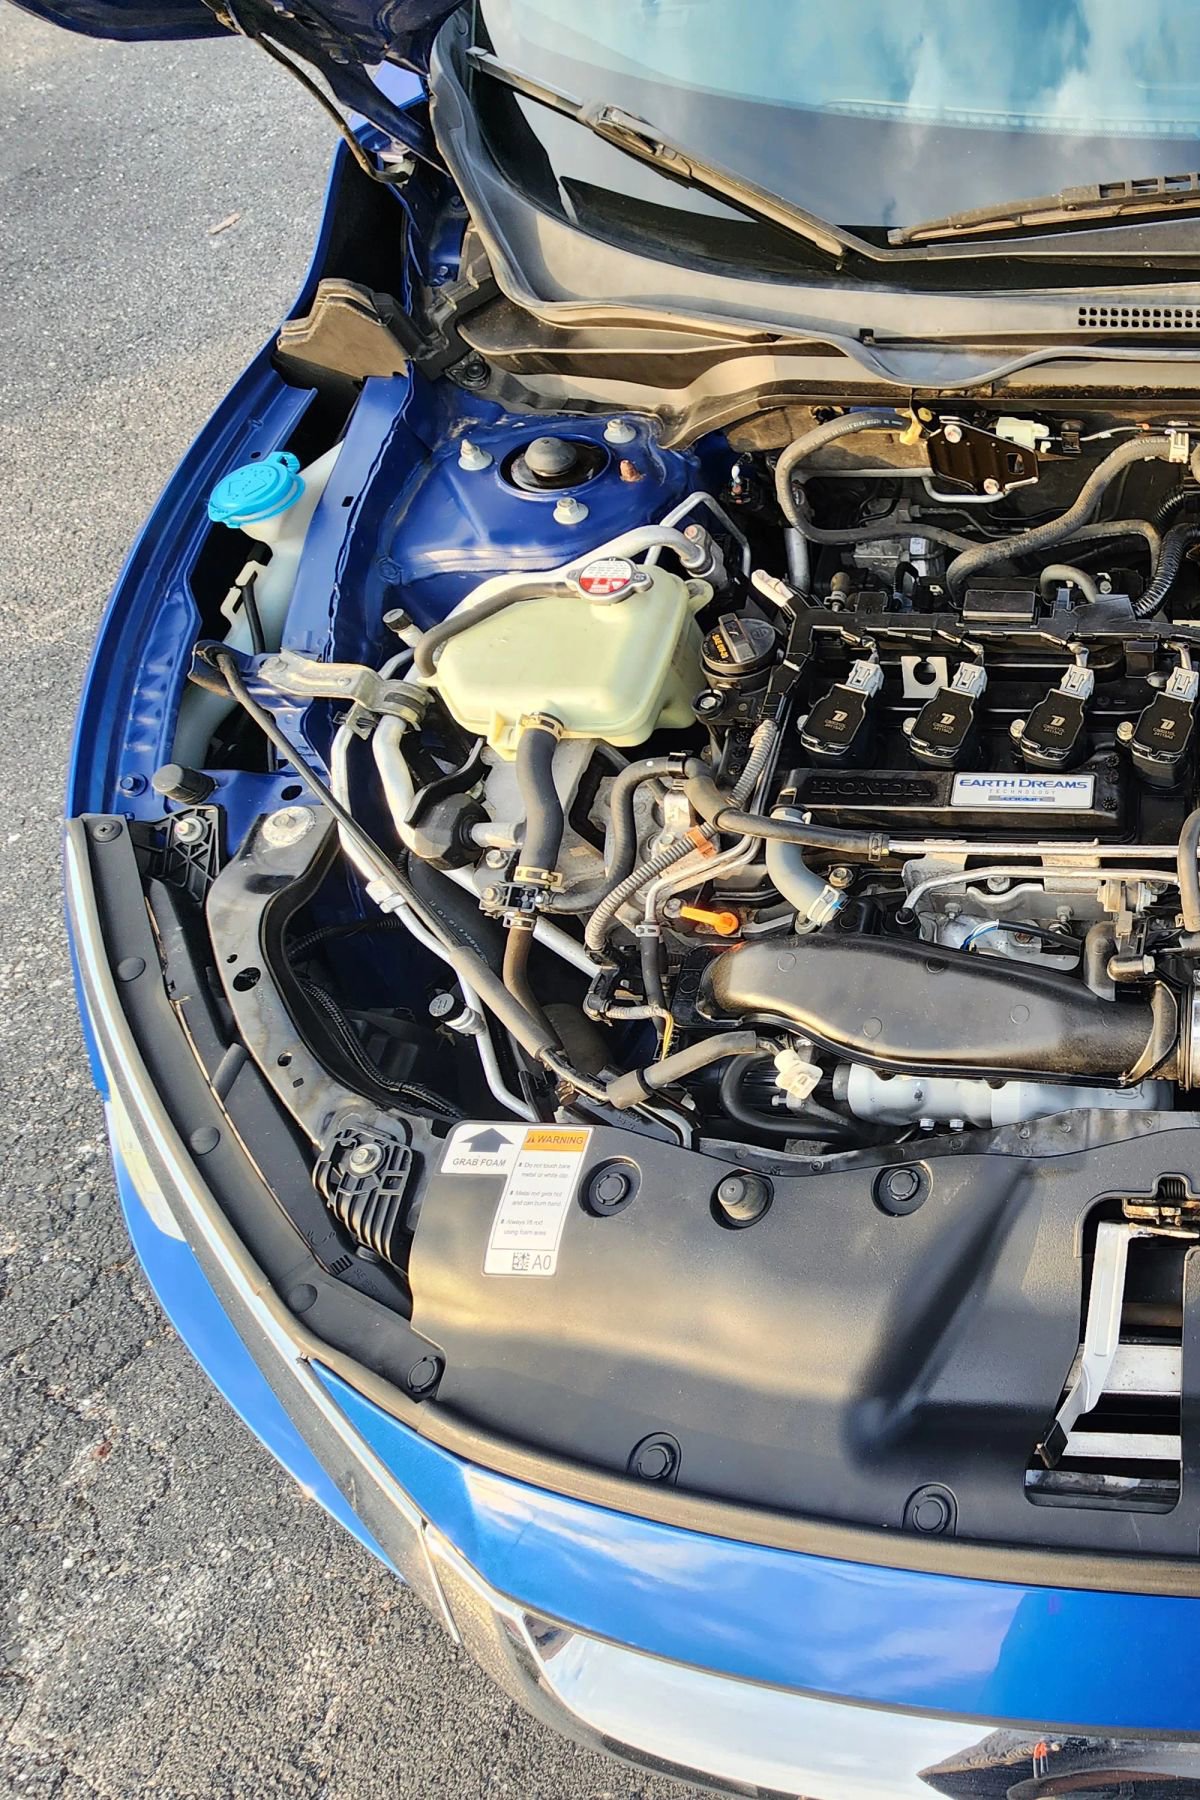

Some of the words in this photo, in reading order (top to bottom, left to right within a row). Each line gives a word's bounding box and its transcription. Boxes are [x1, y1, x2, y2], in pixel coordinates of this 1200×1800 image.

[810, 781, 931, 796] HONDA
[959, 779, 1015, 788] EARTH
[1019, 779, 1088, 789] DREAMS
[537, 1135, 584, 1145] WARNING
[452, 1157, 478, 1167] GRAB
[480, 1158, 507, 1168] FOAM
